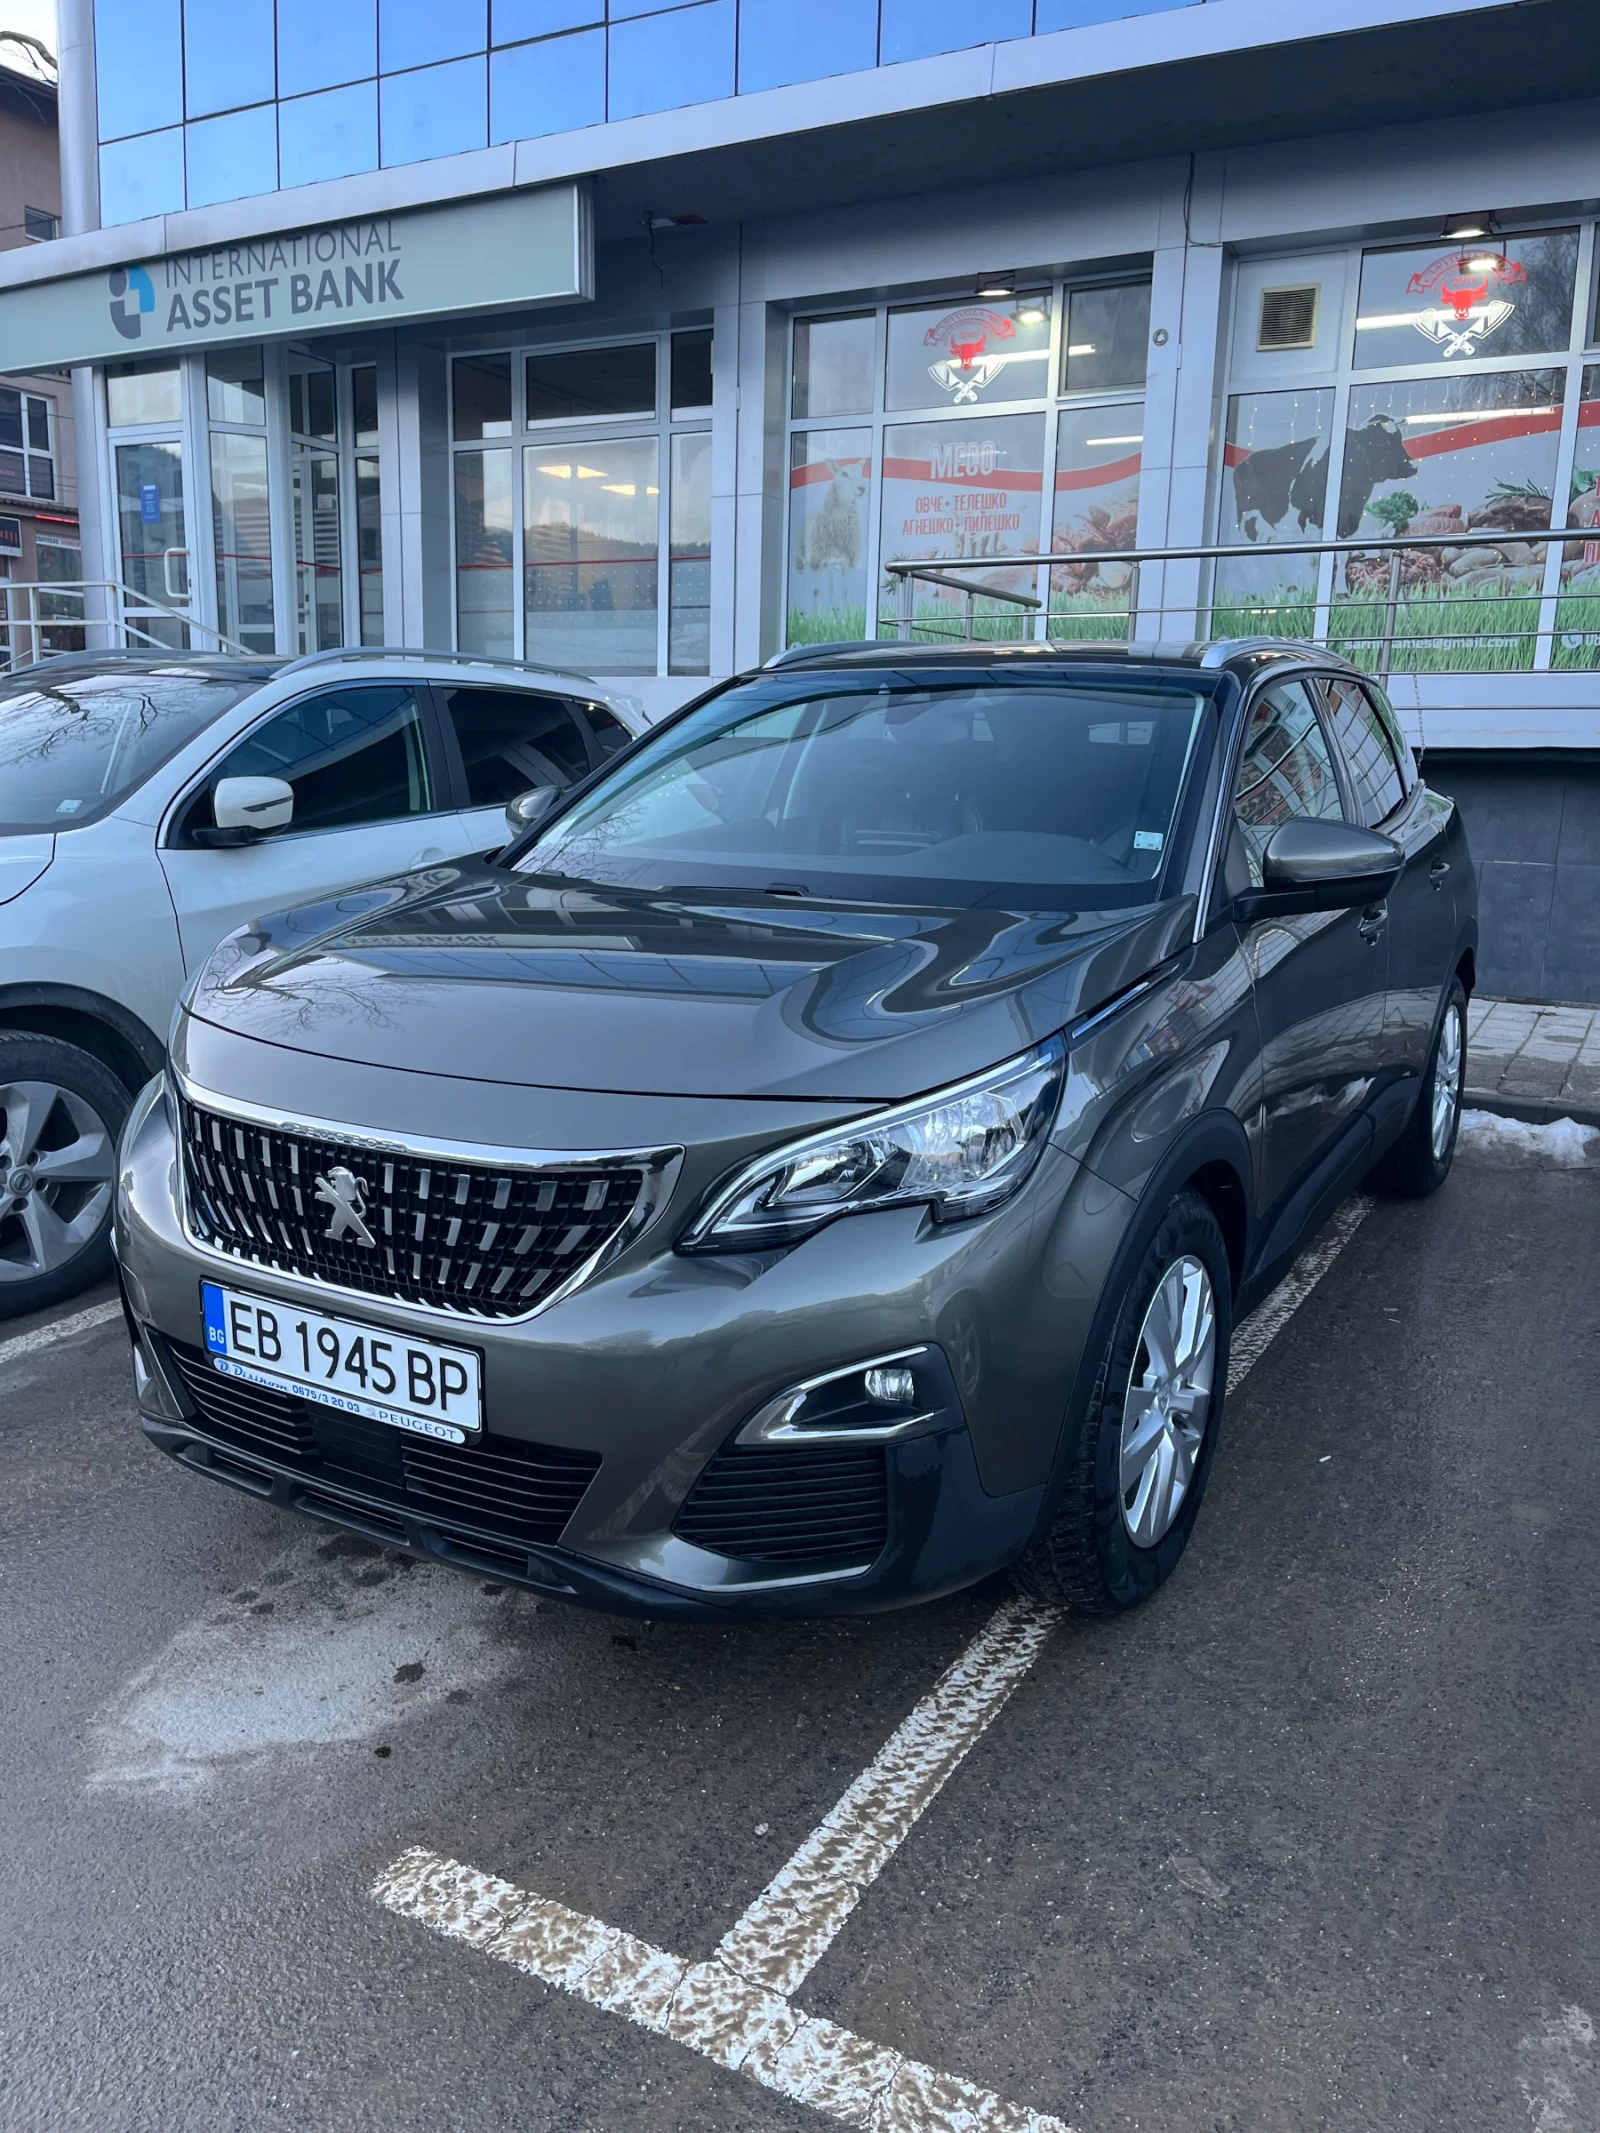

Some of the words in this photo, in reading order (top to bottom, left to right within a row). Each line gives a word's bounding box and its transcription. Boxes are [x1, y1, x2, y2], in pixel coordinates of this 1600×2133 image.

[165, 220, 401, 288] INTERNATIONAL
[166, 277, 279, 332] ASSET
[290, 258, 405, 315] BANK
[930, 440, 997, 479] МЕСО
[902, 517, 953, 535] АГНЕШКО
[964, 513, 1020, 533] ПИЛЕШКО
[915, 496, 943, 513] ОВЧЕ
[953, 492, 1007, 511] ТЕЛЕШКО
[209, 1326, 225, 1344] BG
[230, 1300, 282, 1362] EB
[295, 1321, 397, 1395] 1945
[407, 1348, 468, 1411] BP
[292, 1384, 328, 1404] 0675/3
[331, 1397, 344, 1409] 20
[347, 1401, 360, 1413] 03
[379, 1410, 456, 1440] PEUGEOT
